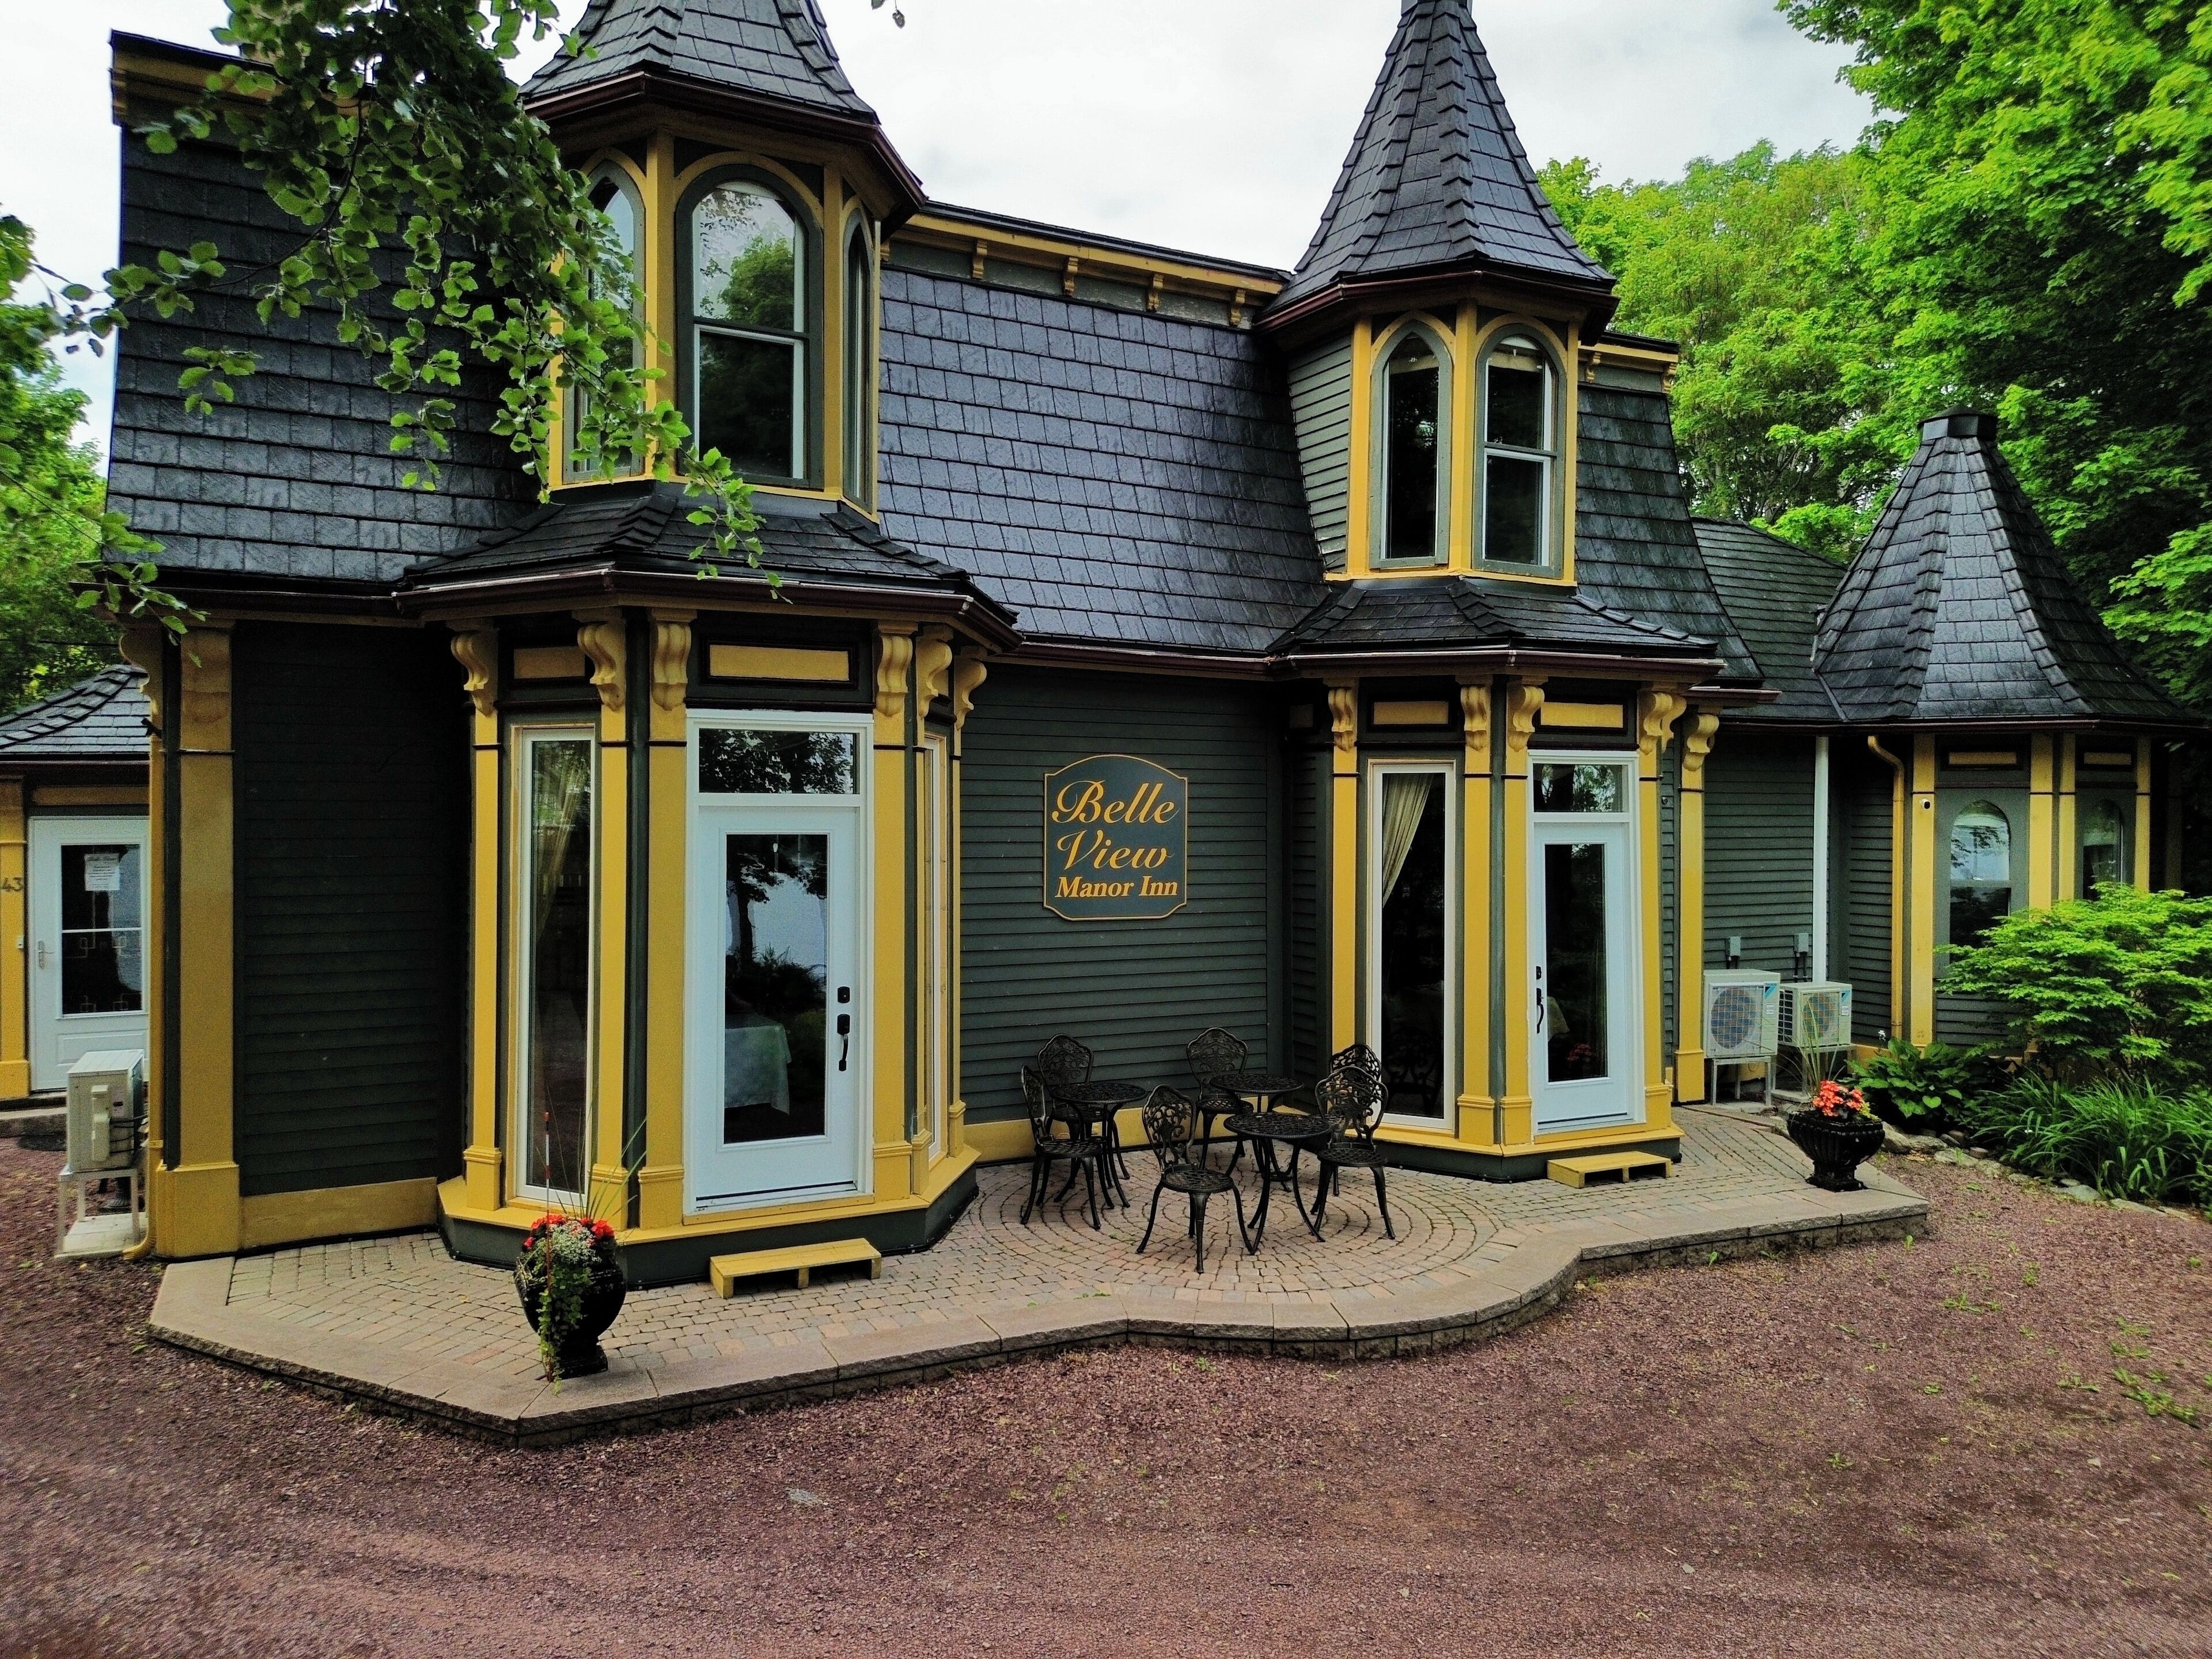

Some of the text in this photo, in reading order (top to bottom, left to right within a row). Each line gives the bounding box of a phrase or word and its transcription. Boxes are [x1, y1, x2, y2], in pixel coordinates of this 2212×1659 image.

[1051, 779, 1179, 824] Belle
[1056, 830, 1175, 870] View
[1054, 875, 1178, 898] Manor Inn
